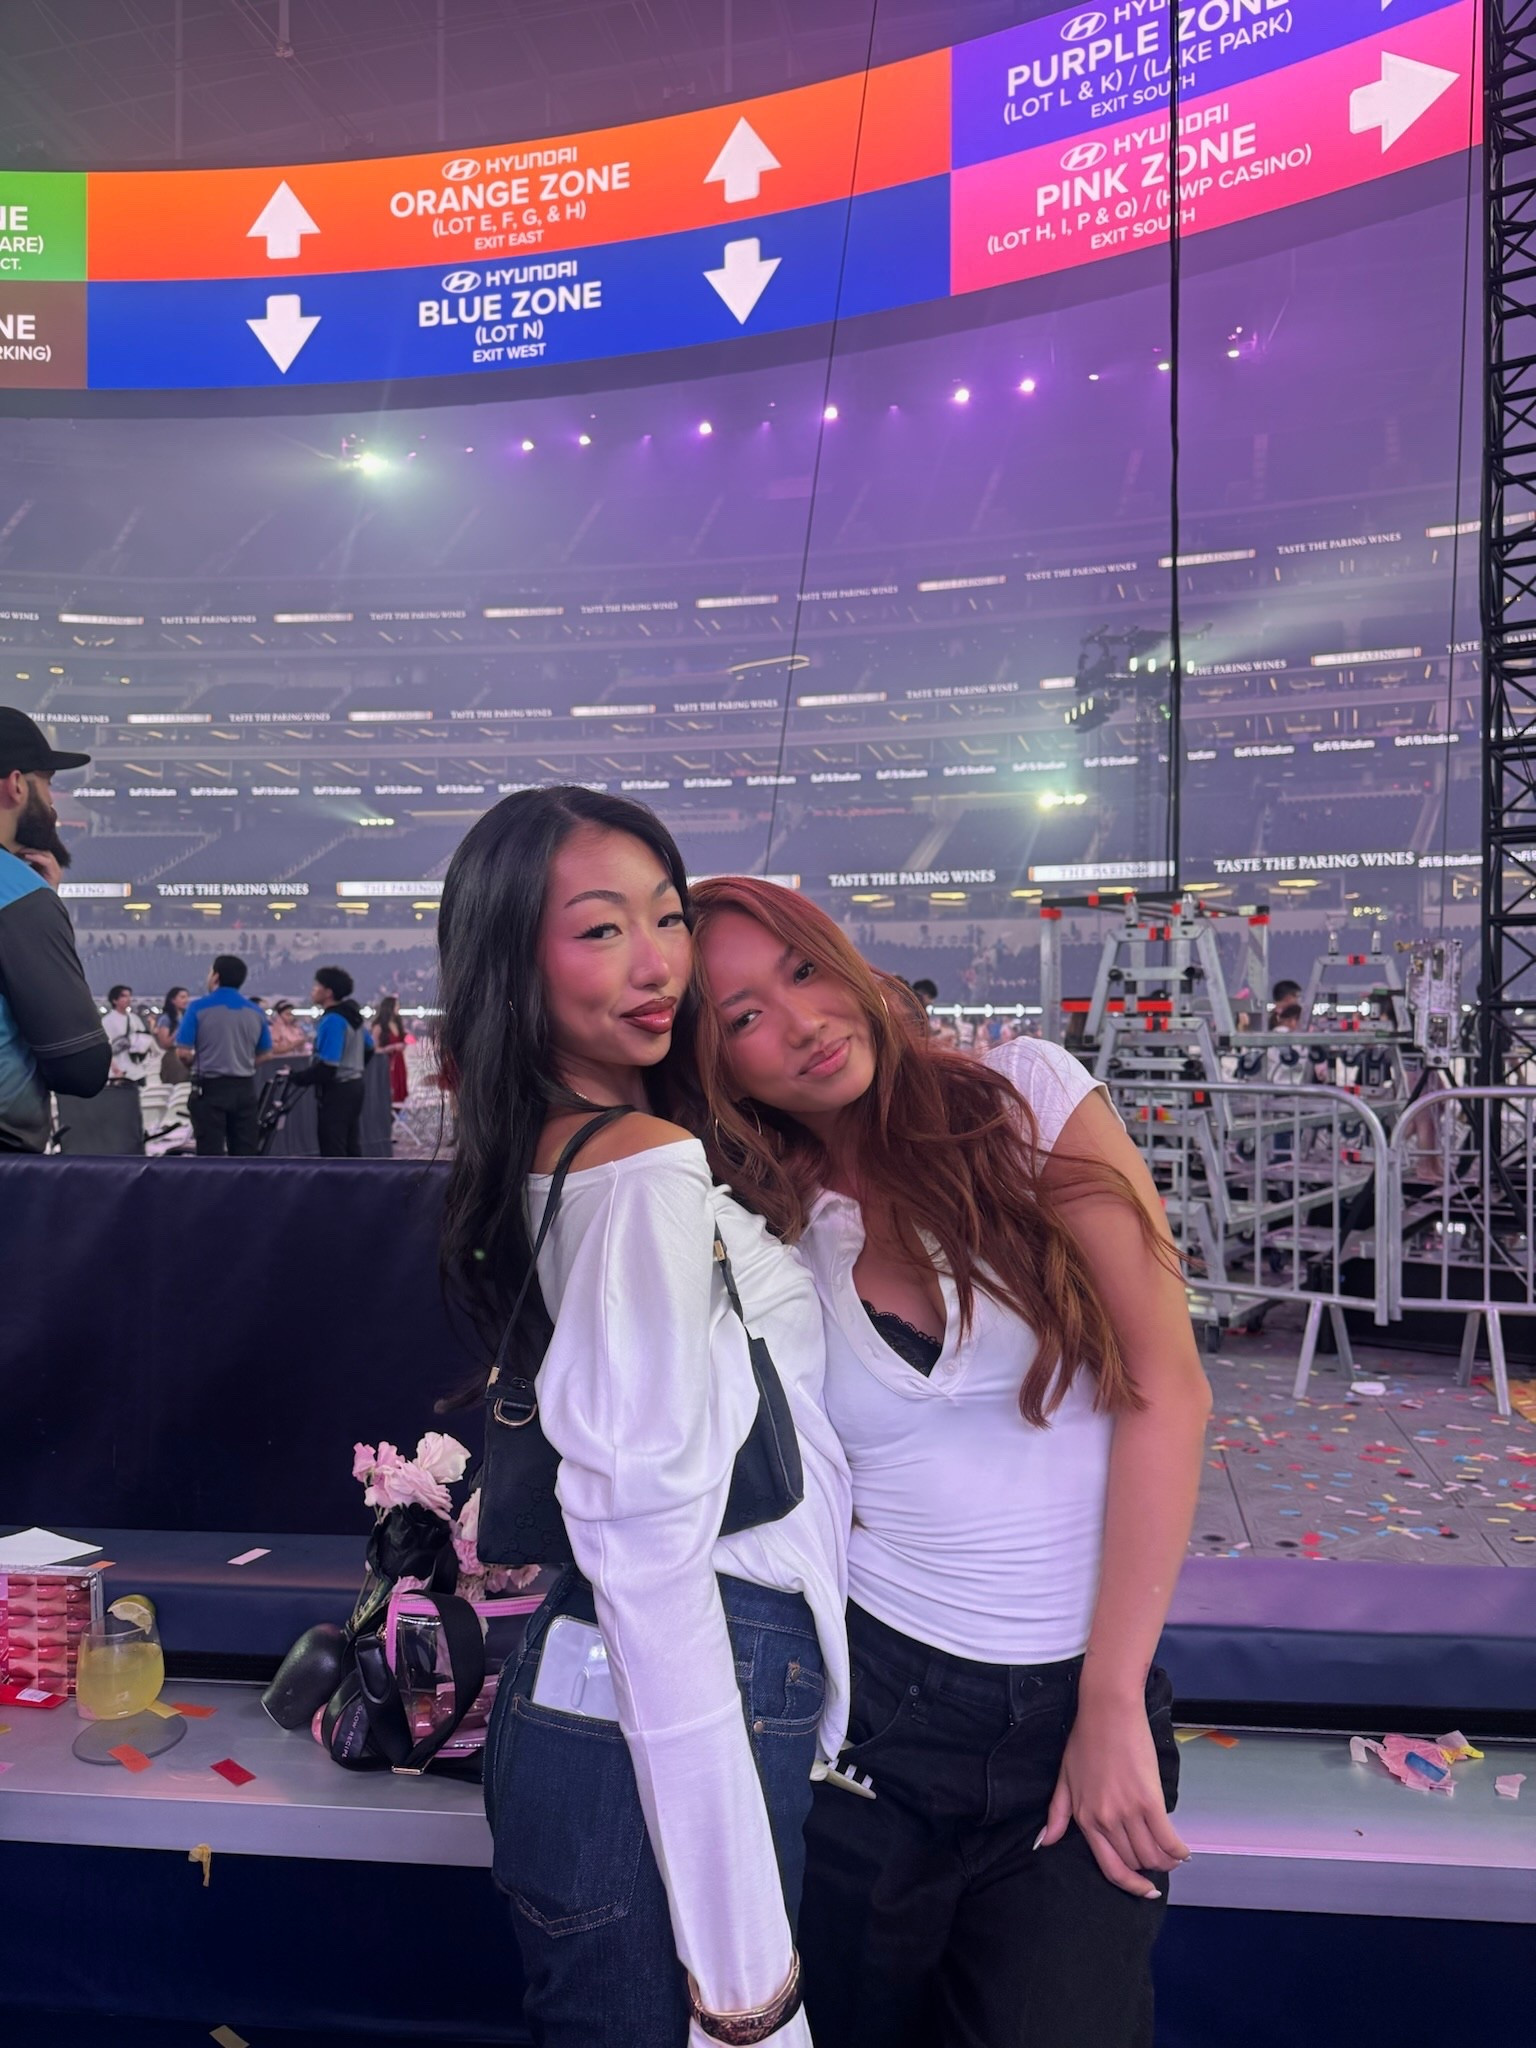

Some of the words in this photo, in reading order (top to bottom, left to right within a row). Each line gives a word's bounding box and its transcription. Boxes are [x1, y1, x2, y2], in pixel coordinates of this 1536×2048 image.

[1004, 93, 1053, 125] (LOT
[1060, 88, 1072, 107] L
[1078, 81, 1093, 101] &
[1101, 68, 1122, 94] K)
[1128, 64, 1138, 86] /
[1219, 9, 1293, 54] PARK)
[1008, 21, 1159, 97] PURPLE
[1090, 95, 1128, 119] EXIT
[1133, 72, 1196, 105] SOUH
[485, 147, 578, 174] HYUNDAI
[1036, 163, 1128, 218] PINK
[1141, 122, 1256, 188] ZONE
[390, 178, 530, 218] ORANGE
[539, 162, 630, 202] ZONE
[987, 228, 1031, 256] (LOT
[1036, 221, 1056, 242] H,
[1078, 212, 1090, 230] P
[1095, 206, 1110, 225] &
[1115, 197, 1138, 220] Q)
[1142, 193, 1152, 213] /
[1218, 143, 1312, 190] CASINO)
[432, 216, 475, 238] (LOT
[480, 214, 497, 232] E,
[502, 212, 518, 230] F,
[522, 208, 543, 227] G,
[546, 205, 560, 223] &
[566, 200, 586, 220] H)
[1090, 227, 1128, 251] EXIT
[1132, 207, 1196, 238] SOUH
[474, 235, 505, 251] EXIT
[508, 230, 544, 247] EAST
[486, 260, 578, 288] HYUNDAI
[418, 294, 502, 328] BLUE
[511, 280, 602, 319] ZONE
[475, 324, 519, 346] (LOT
[523, 319, 544, 340] N)
[472, 347, 504, 363] EXIT
[506, 342, 546, 360] WEST
[1446, 640, 1480, 654] TASTE
[1213, 858, 1262, 873] TASTE
[1263, 856, 1296, 872] THE
[1298, 854, 1360, 870] PARING
[1360, 850, 1415, 868] WINES
[157, 884, 194, 896] TASTE
[195, 883, 221, 896] THE
[222, 883, 268, 896] PARING
[268, 883, 310, 896] WINES
[828, 873, 869, 888] TASTE
[870, 872, 898, 886] THE
[899, 870, 950, 886] PARING
[950, 868, 997, 884] WINES
[342, 1731, 354, 1758] RECIPE
